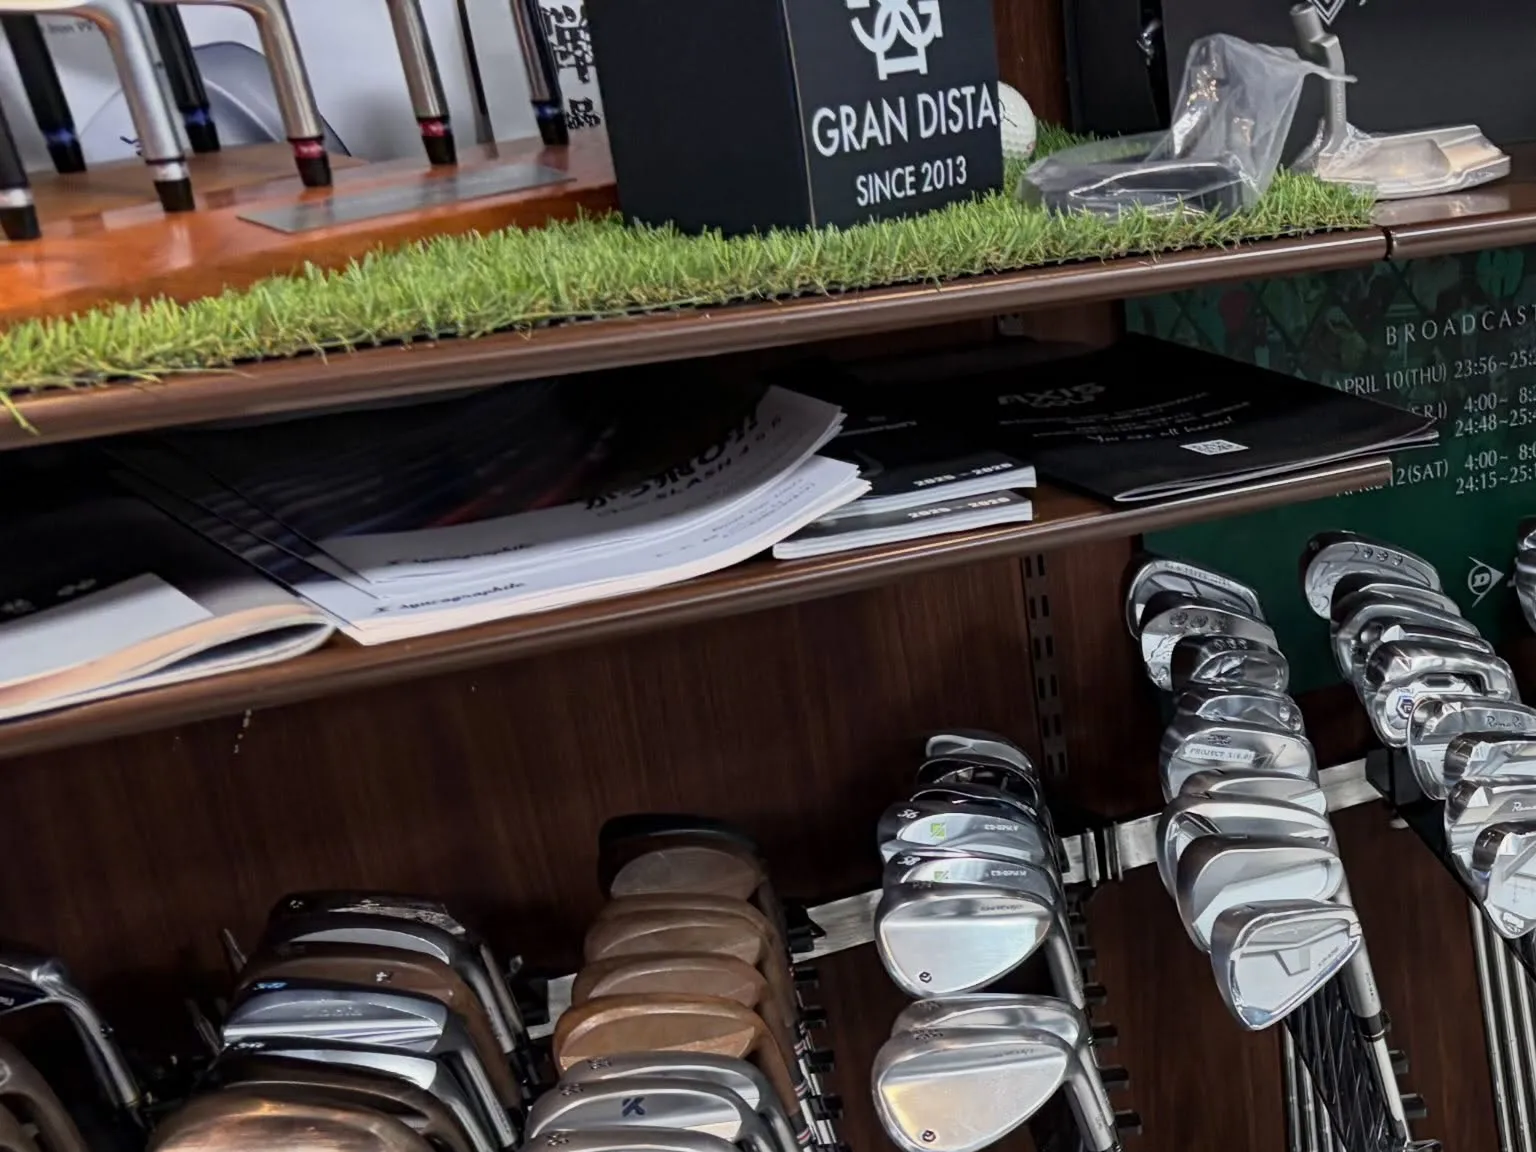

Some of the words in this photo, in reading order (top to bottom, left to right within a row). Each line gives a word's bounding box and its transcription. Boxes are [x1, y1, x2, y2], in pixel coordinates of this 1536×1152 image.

[812, 97, 909, 157] GRAN
[916, 82, 998, 139] DISTA
[856, 165, 917, 207] SINCE
[921, 155, 967, 194] 2013
